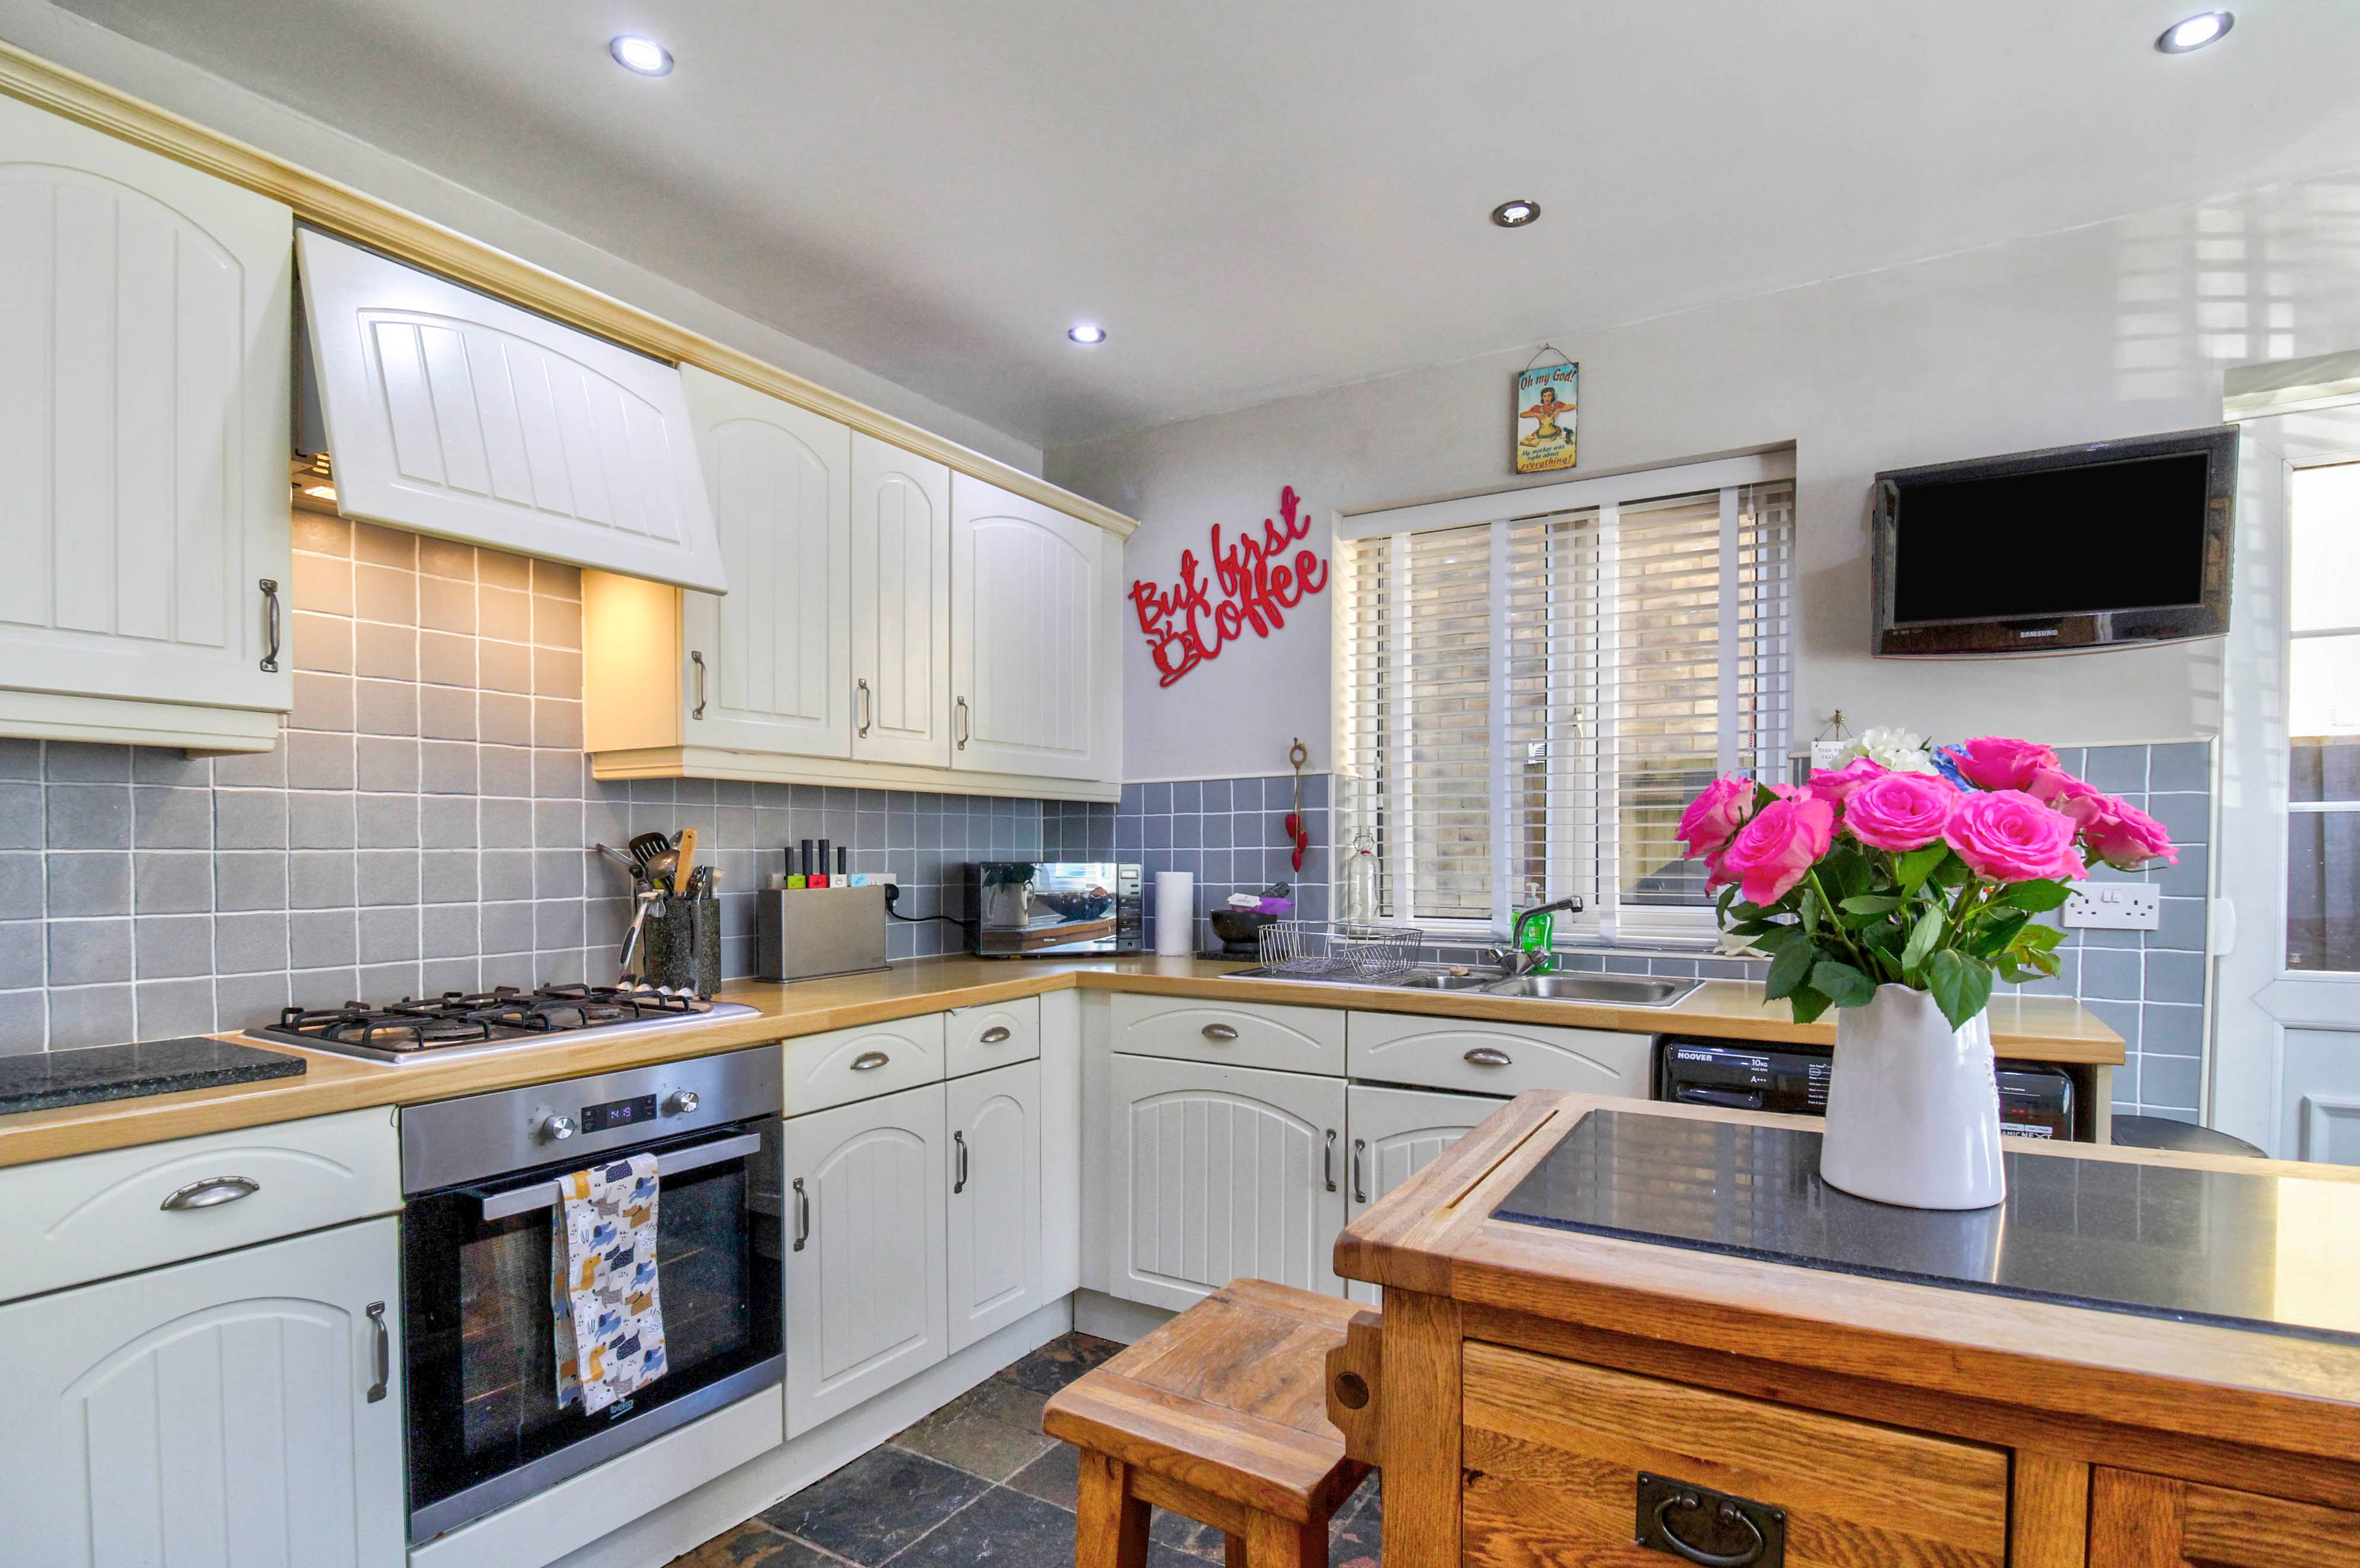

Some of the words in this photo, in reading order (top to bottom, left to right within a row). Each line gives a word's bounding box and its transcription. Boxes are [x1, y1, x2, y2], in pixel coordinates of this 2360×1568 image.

[1520, 374, 1533, 390] Oh
[1536, 374, 1550, 386] my
[1553, 369, 1576, 383] God!
[1521, 454, 1572, 469] everything!
[1128, 549, 1208, 633] But
[1211, 485, 1311, 597] first
[1678, 1052, 1712, 1062] HOOVER
[1752, 1059, 1768, 1067] 10KG
[610, 1398, 633, 1414] beko
